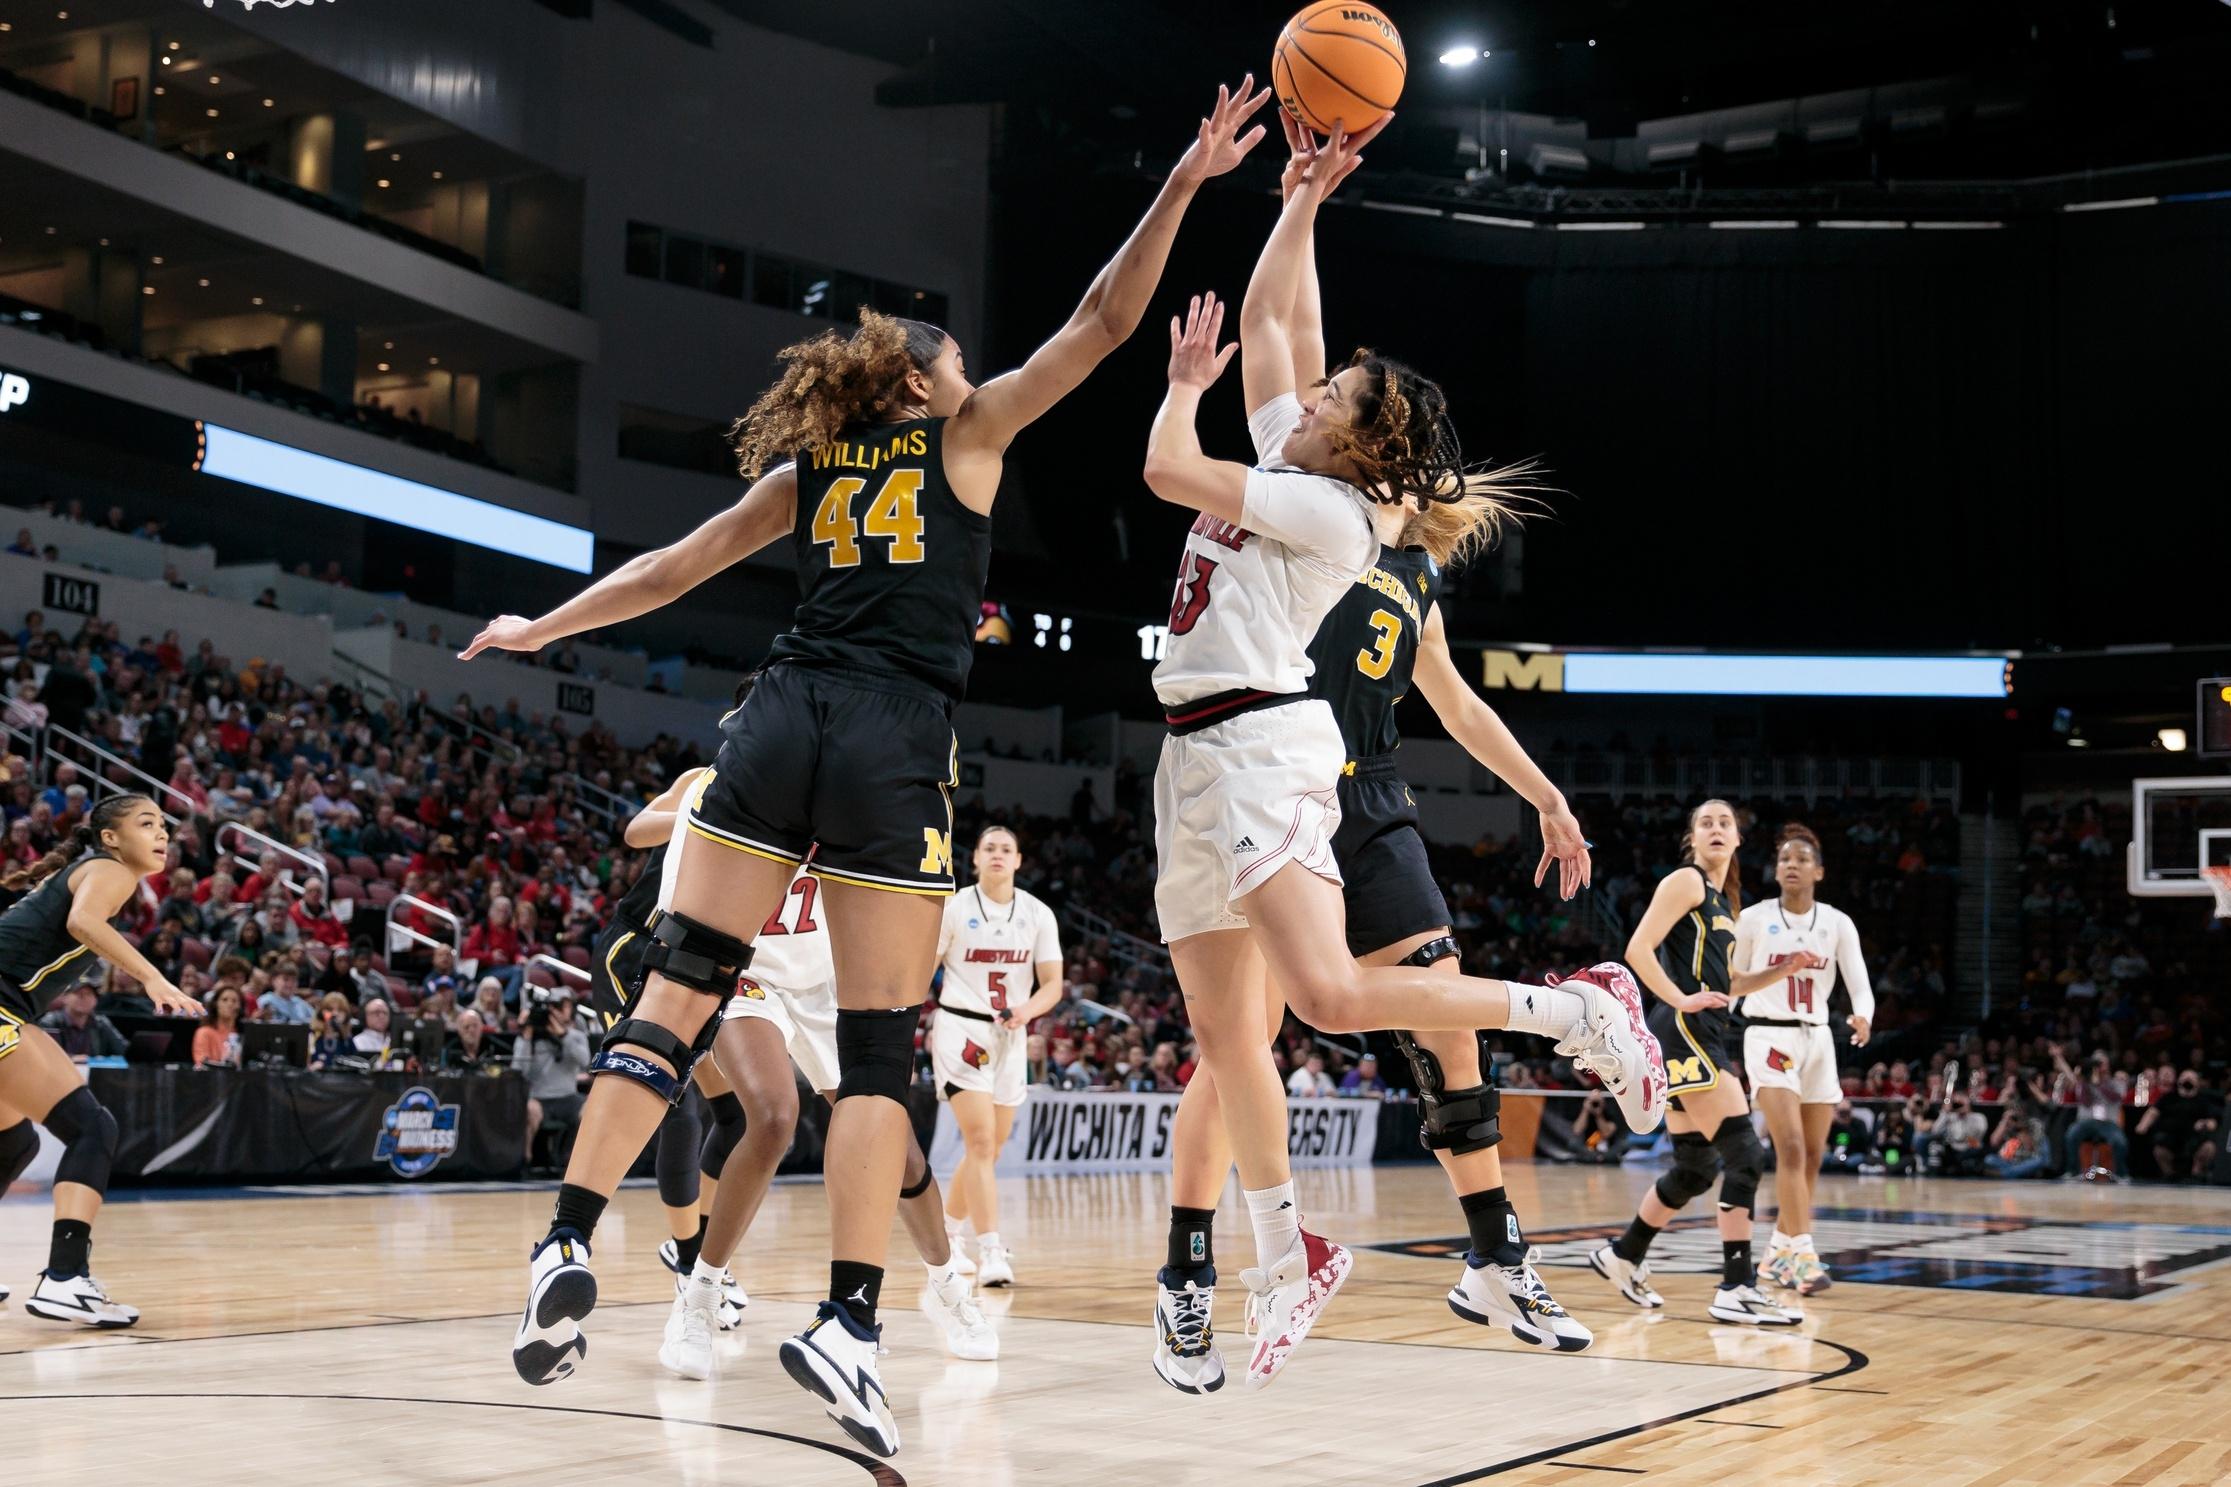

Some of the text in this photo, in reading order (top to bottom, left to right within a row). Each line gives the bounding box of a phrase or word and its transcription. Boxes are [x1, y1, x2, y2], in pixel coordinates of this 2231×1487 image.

[0, 371, 30, 412] P
[811, 468, 925, 569] 44
[1356, 608, 1402, 680] 3
[1482, 650, 1564, 691] M
[919, 827, 953, 877] M
[1233, 845, 1259, 855] adidas
[988, 971, 1008, 1011] 5
[1668, 1056, 1703, 1084] M
[1026, 1102, 1146, 1161] WICHITA
[1286, 1107, 1362, 1157] ERSITY
